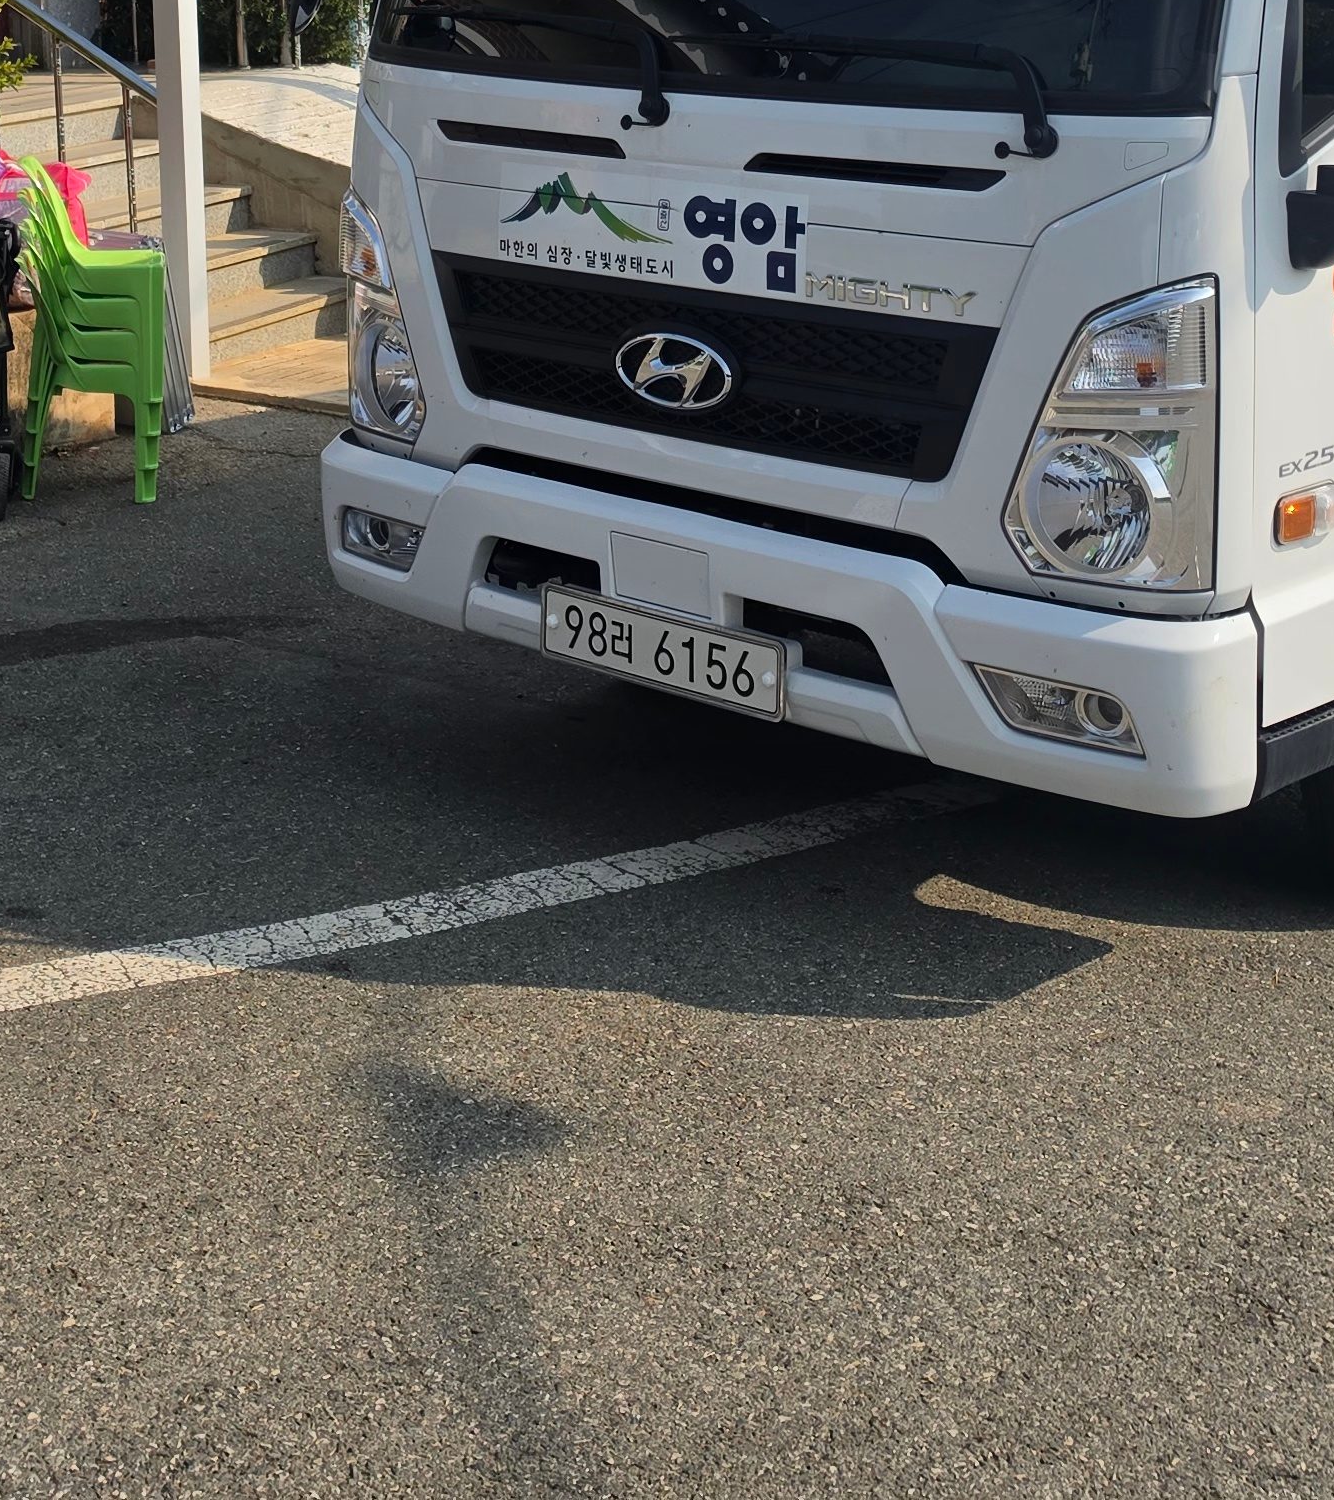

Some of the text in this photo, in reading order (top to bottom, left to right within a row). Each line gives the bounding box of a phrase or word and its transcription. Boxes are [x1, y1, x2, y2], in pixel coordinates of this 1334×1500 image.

[499, 238, 538, 261] 마한의
[683, 195, 806, 293] 영암
[805, 271, 979, 318] MIGHTY
[1278, 444, 1334, 479] EX25
[563, 604, 756, 699] 98러 6156
